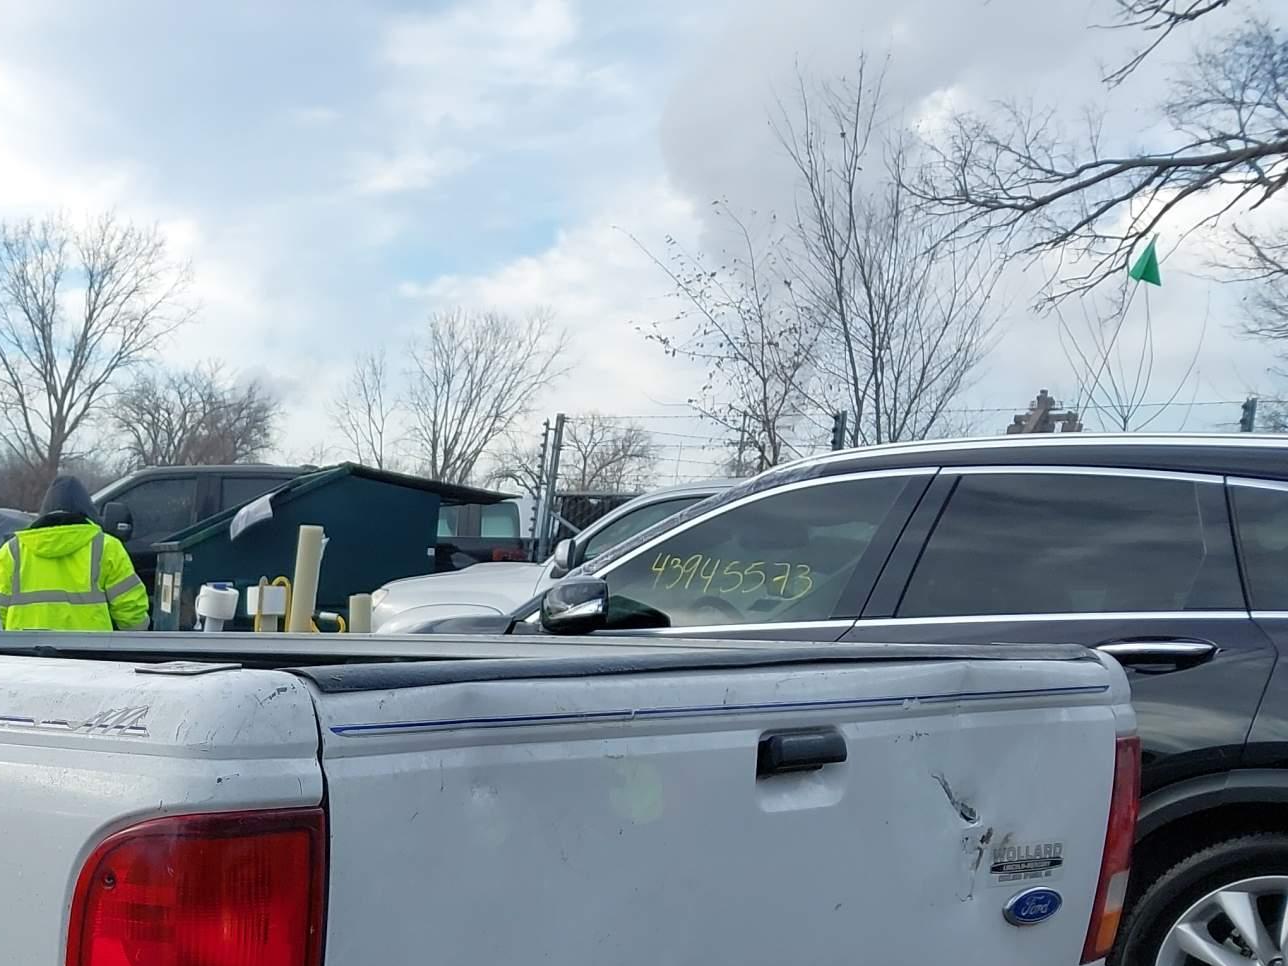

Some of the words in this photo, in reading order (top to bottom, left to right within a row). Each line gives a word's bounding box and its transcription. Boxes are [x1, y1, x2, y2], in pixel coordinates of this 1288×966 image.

[650, 552, 814, 600] 43945573
[993, 842, 1062, 862] WOLLARD
[1020, 895, 1051, 916] Ford
